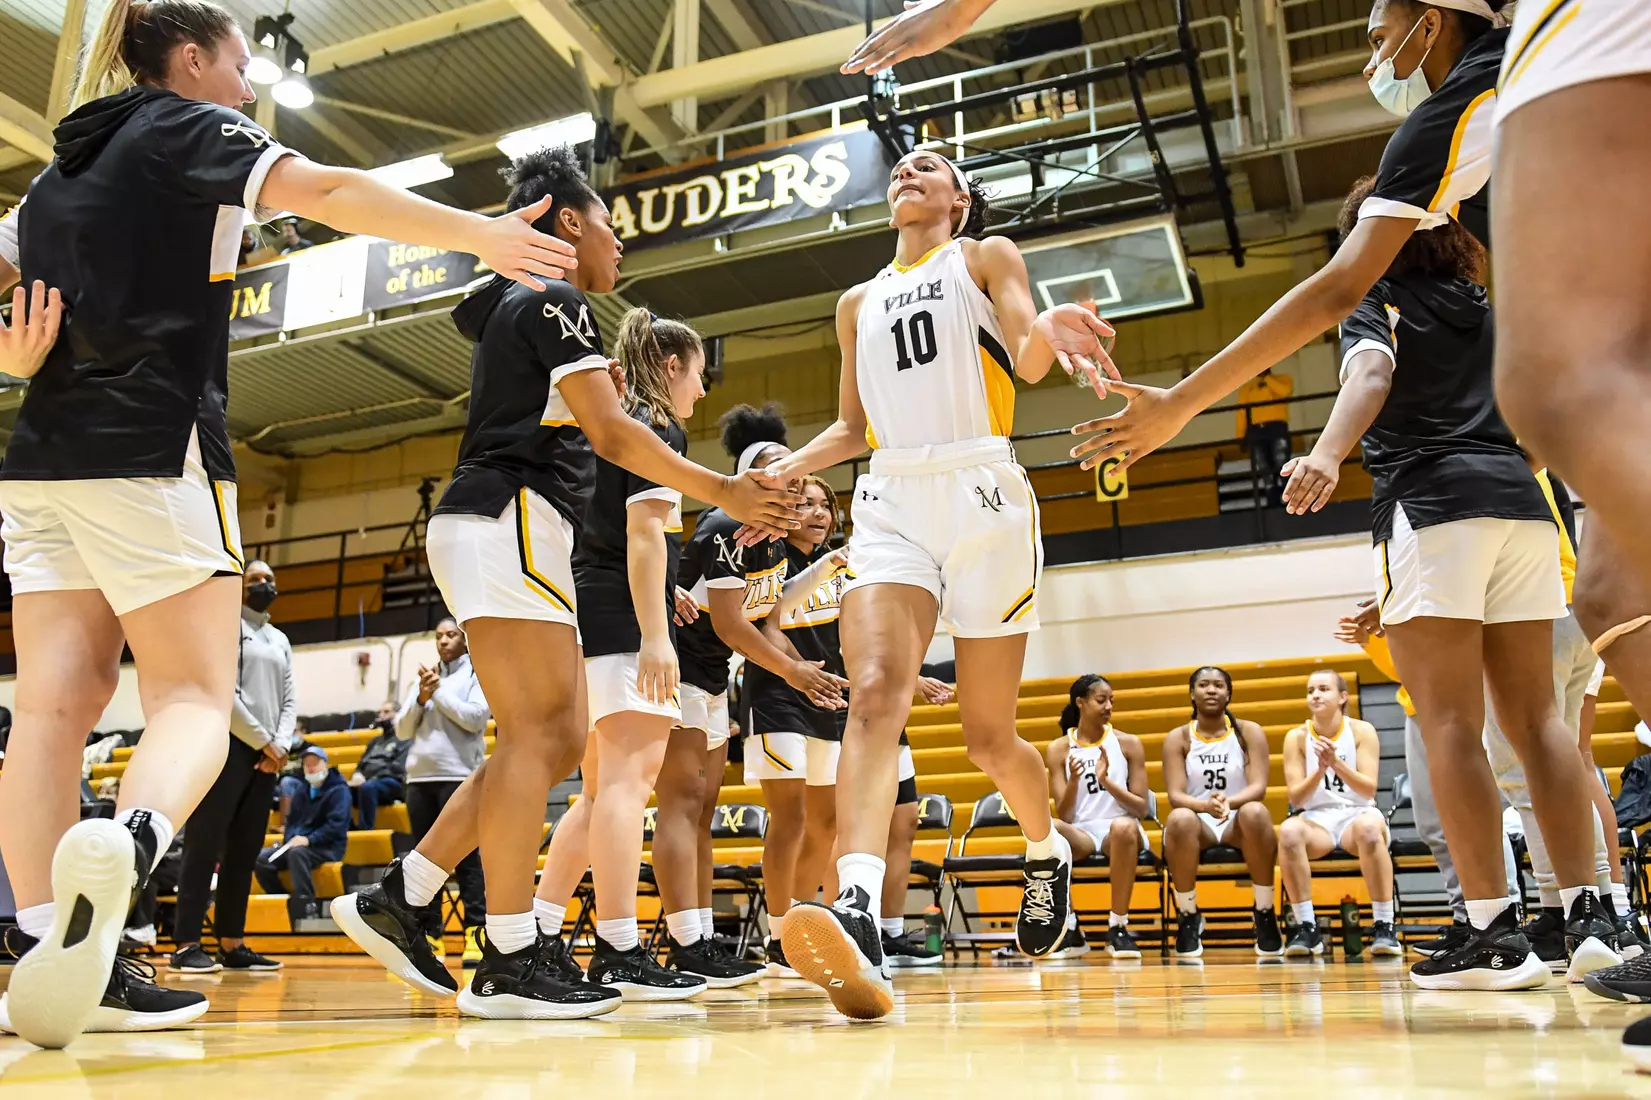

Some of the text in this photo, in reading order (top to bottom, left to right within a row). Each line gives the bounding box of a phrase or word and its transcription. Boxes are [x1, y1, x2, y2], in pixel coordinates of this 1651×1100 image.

[386, 268, 411, 294] of
[412, 264, 447, 288] the
[883, 278, 944, 314] VILLE
[891, 310, 937, 371] 10
[1098, 457, 1125, 497] C
[1199, 752, 1229, 764] VILLE
[1203, 767, 1228, 790] 35
